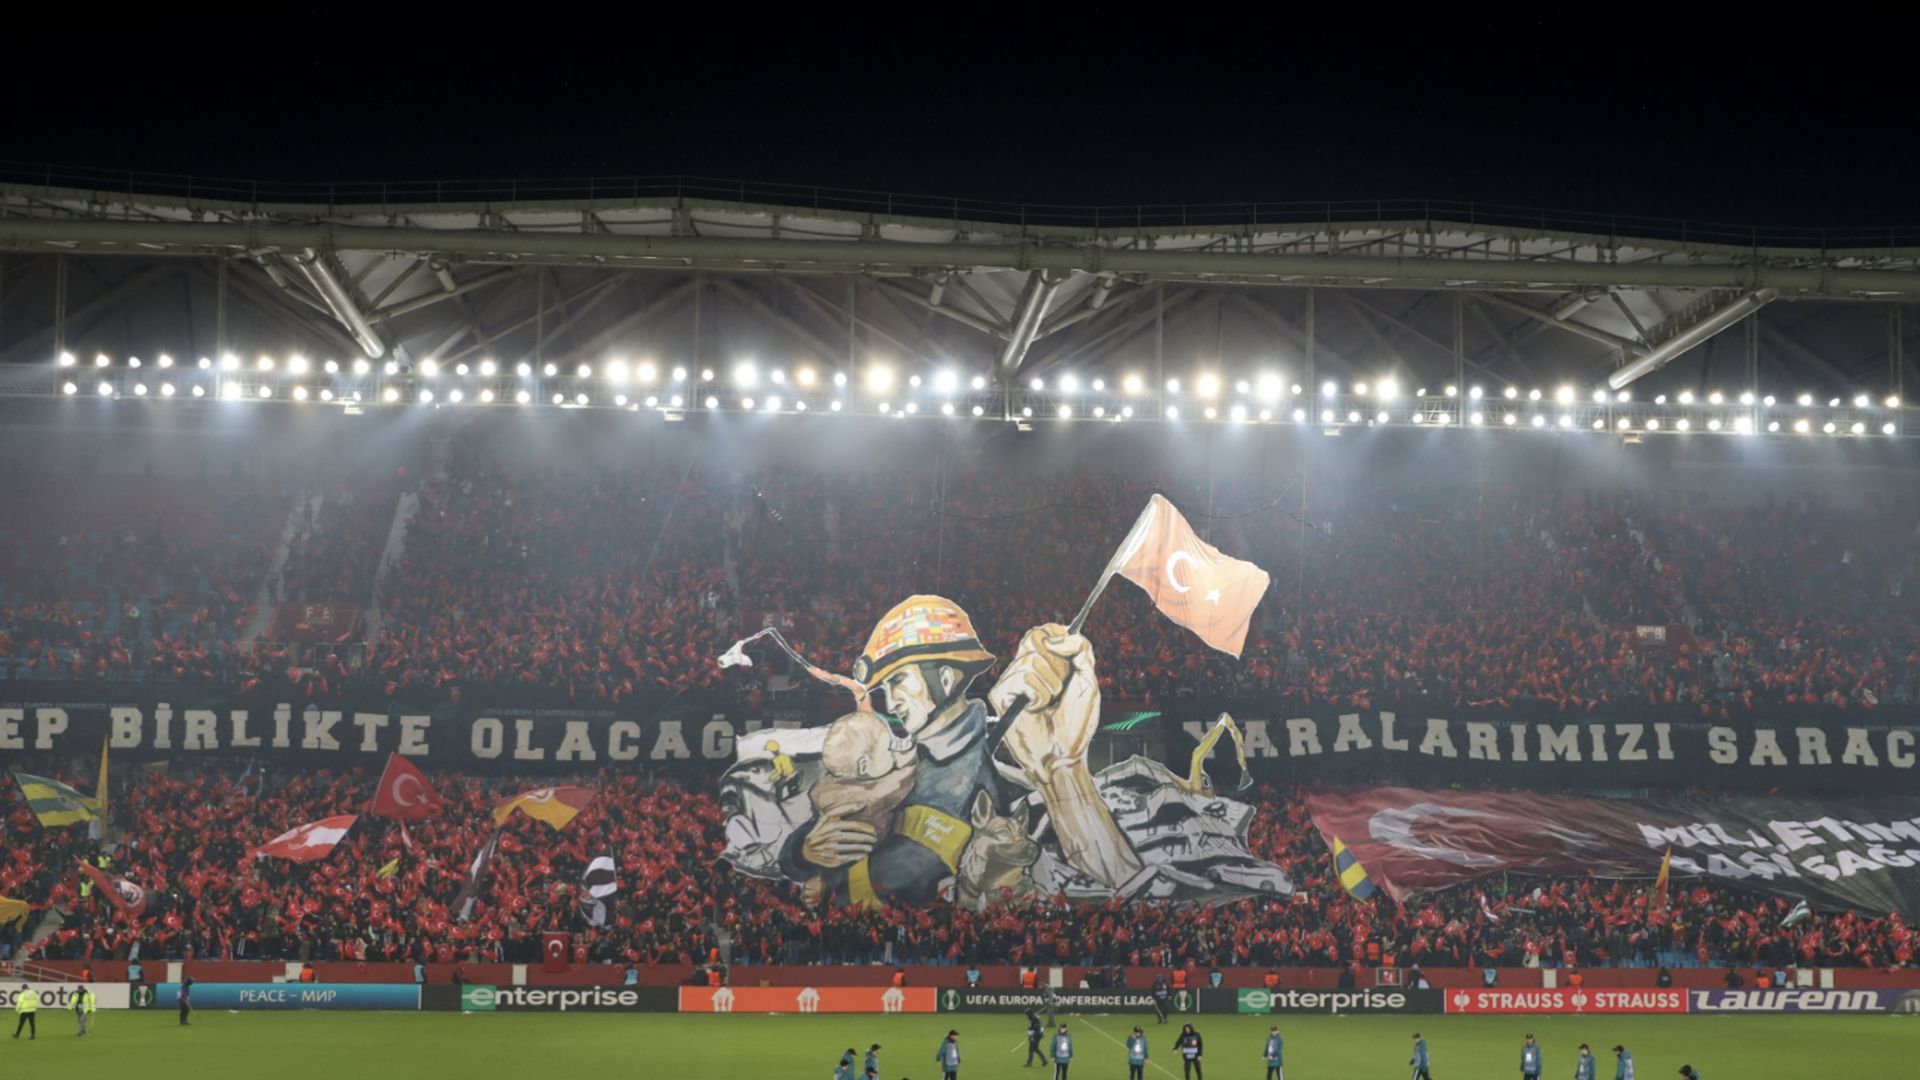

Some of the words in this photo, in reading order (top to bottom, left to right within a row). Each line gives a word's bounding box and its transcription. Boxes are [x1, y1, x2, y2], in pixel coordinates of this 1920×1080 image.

[110, 703, 431, 757] BİRLİKTE
[471, 713, 801, 761] OLACAĞ
[1708, 726, 1916, 768] SARAC
[240, 990, 286, 1002] PEACE
[462, 985, 639, 1011] enterprise
[966, 994, 996, 1005] UEFA
[1000, 994, 1043, 1005] EUROPA
[1055, 994, 1121, 1006] ONFERENCE
[1124, 994, 1155, 1006] LEAG
[1238, 988, 1406, 1013] enterprise
[1477, 993, 1564, 1008] STRAUSS
[1595, 993, 1680, 1008] STRAUSS
